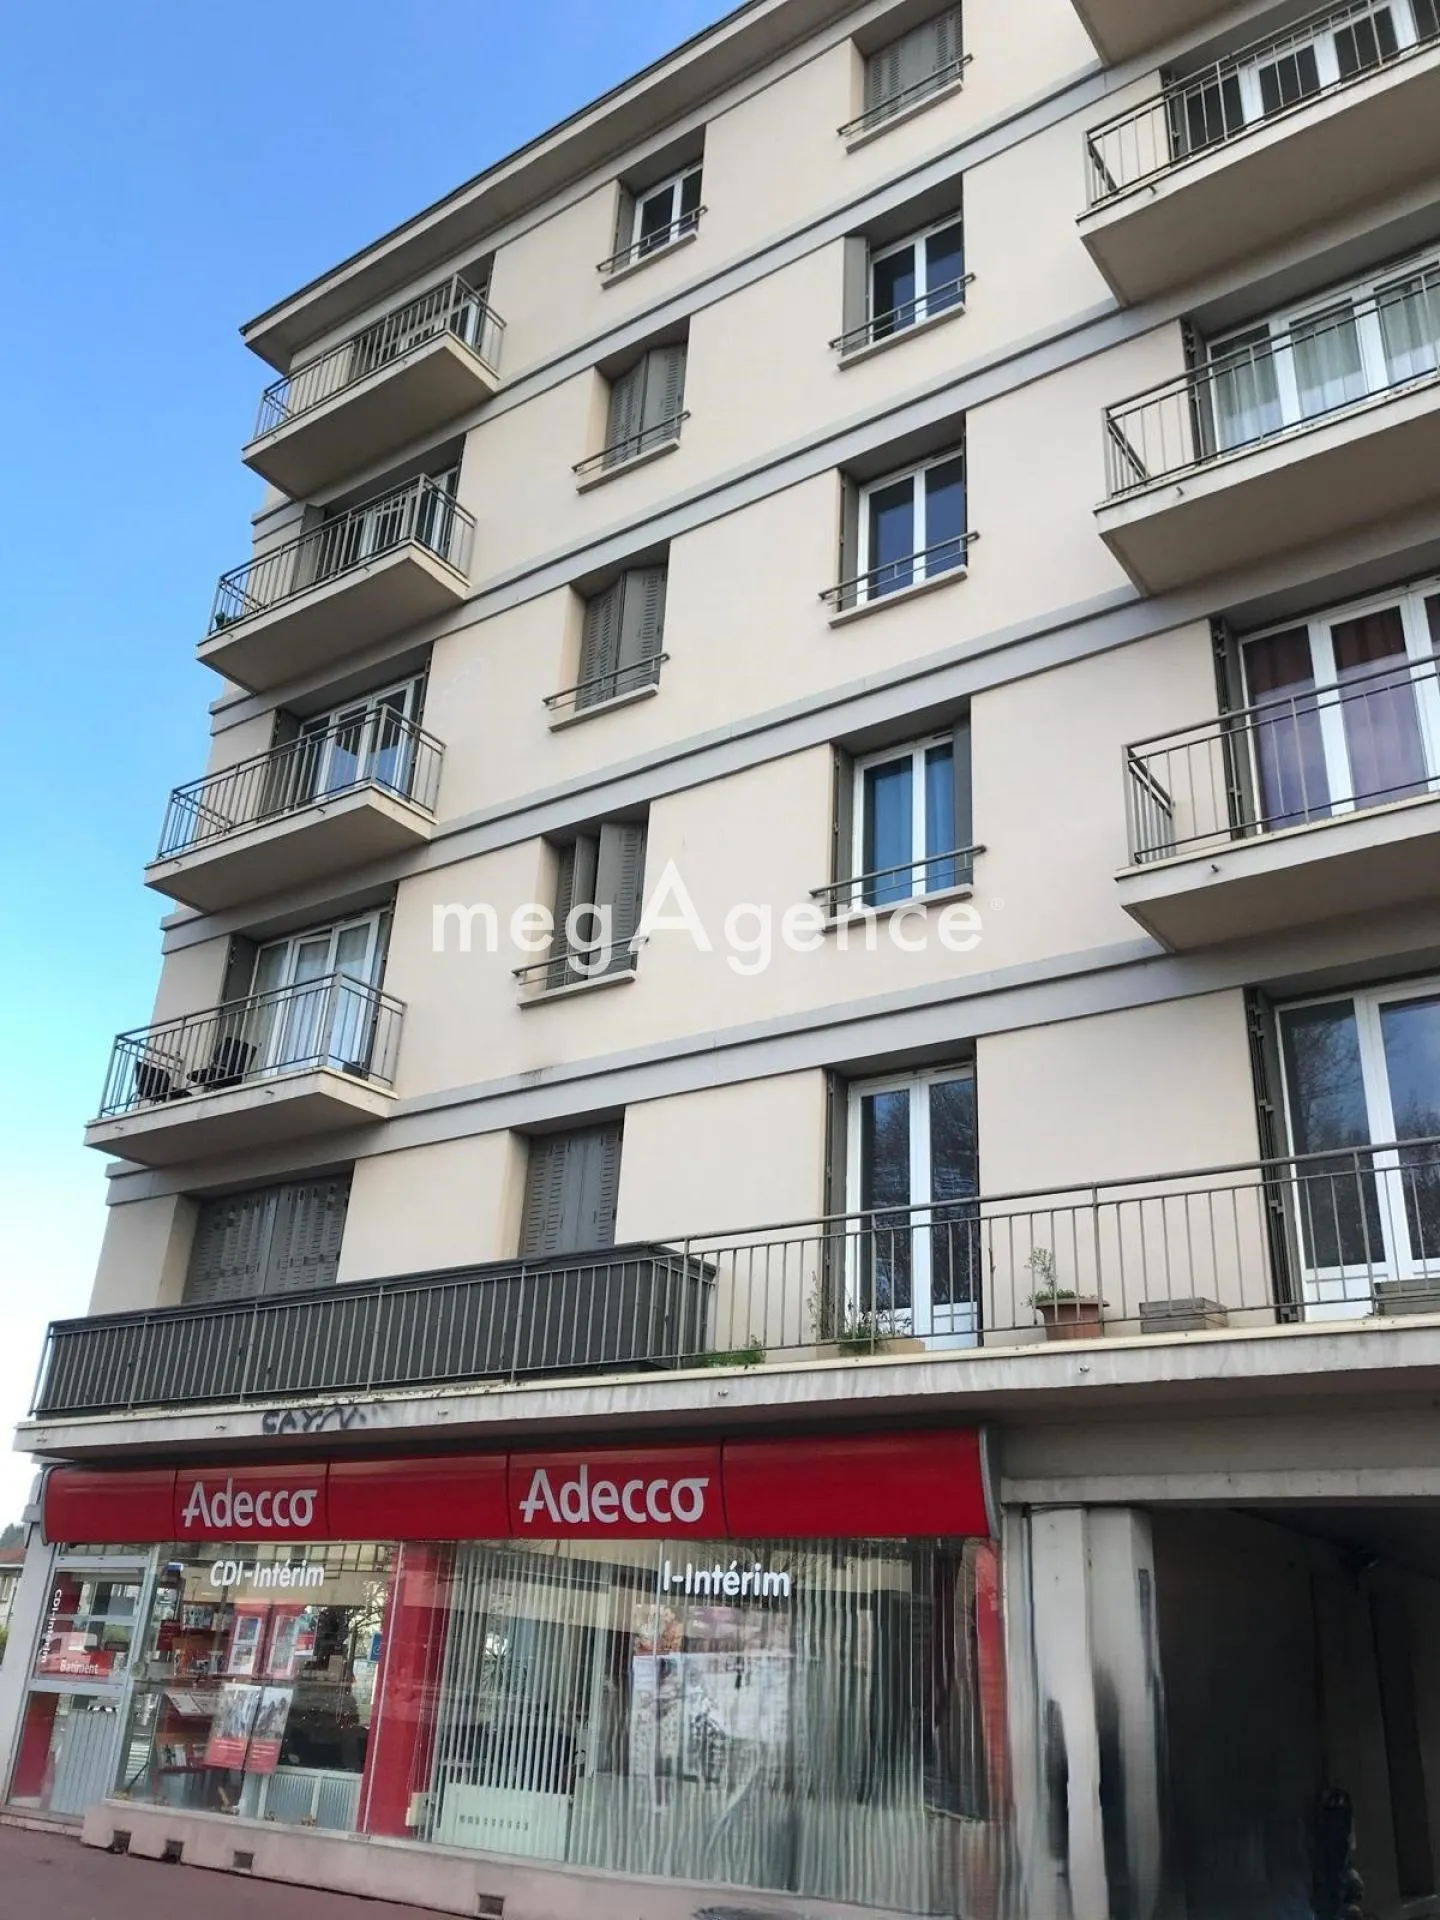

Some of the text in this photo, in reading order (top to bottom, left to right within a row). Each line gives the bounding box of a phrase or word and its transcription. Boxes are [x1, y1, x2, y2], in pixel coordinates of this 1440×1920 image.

[182, 1478, 318, 1527] Adecco
[519, 1465, 709, 1523] Adecco
[210, 1559, 325, 1588] CDI-Intérim
